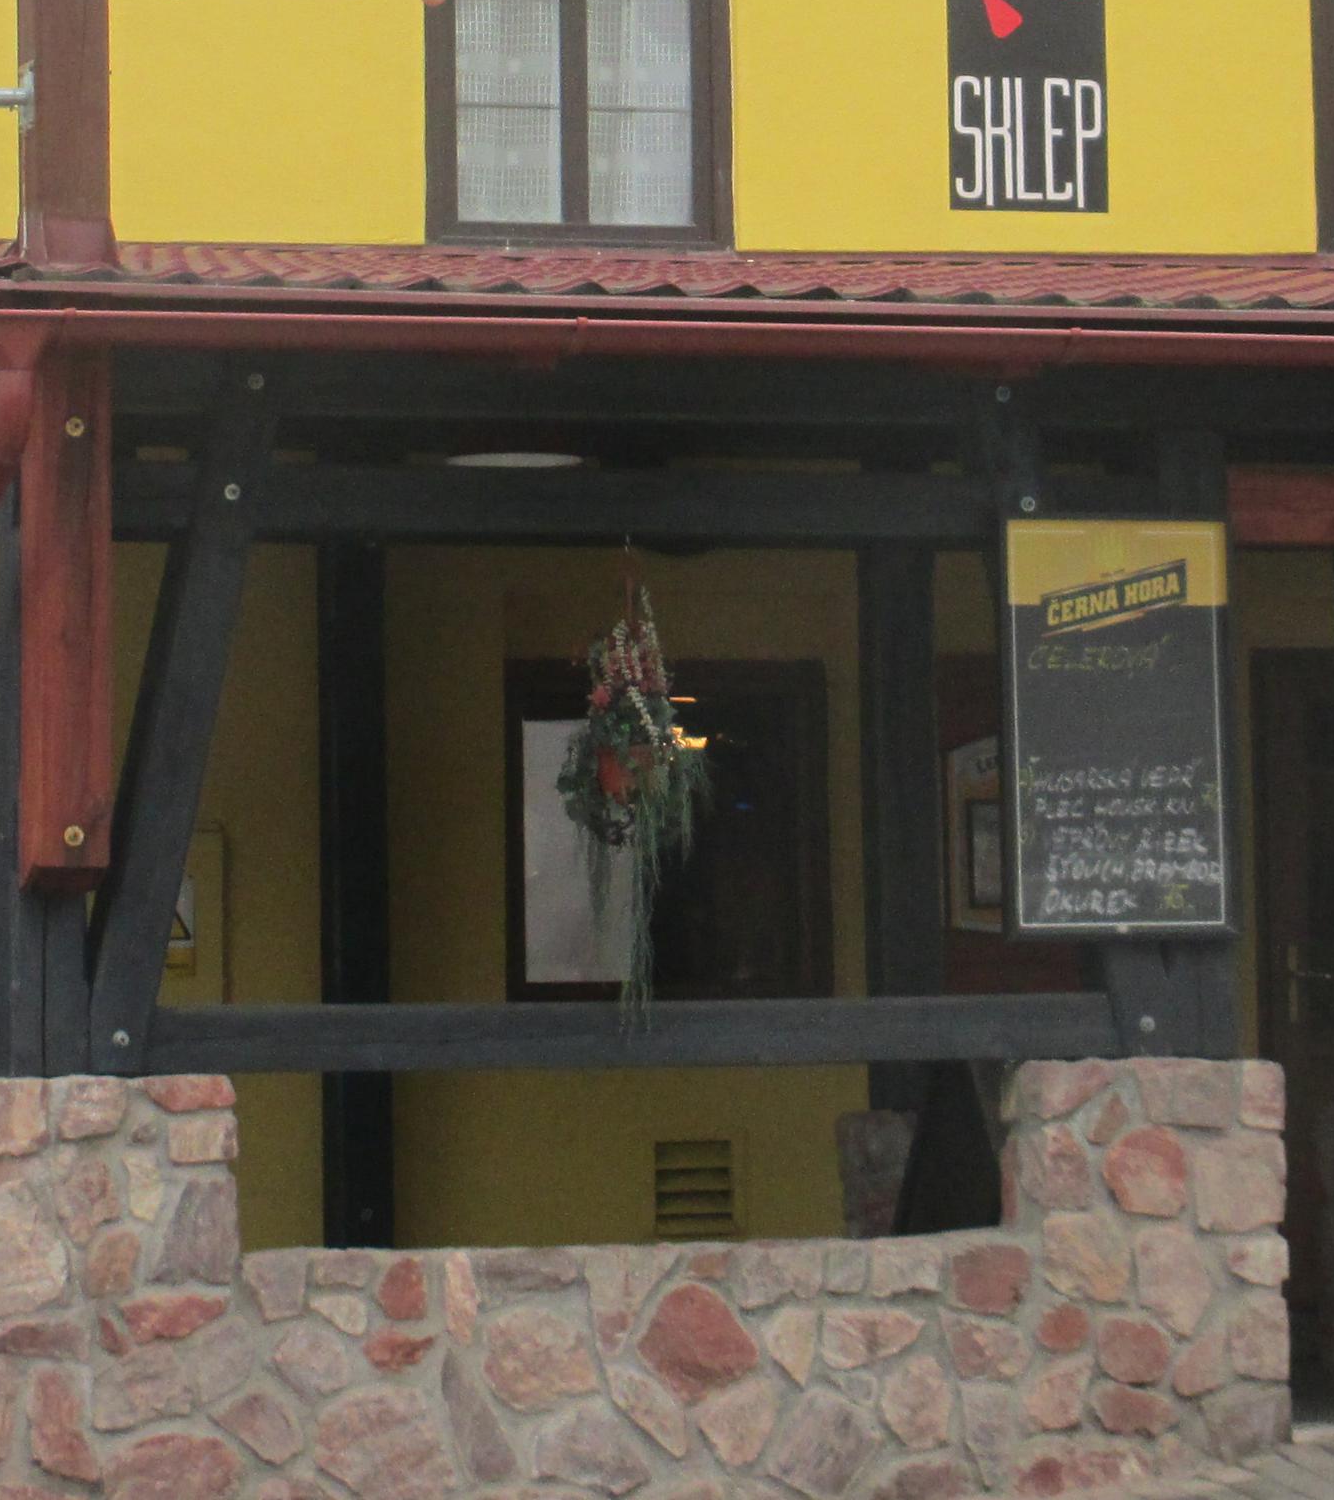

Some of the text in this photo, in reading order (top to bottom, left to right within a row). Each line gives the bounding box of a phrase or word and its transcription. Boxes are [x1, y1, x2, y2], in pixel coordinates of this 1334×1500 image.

[953, 75, 1103, 209] SKLEP
[1046, 571, 1181, 627] ČERNÁ HORA
